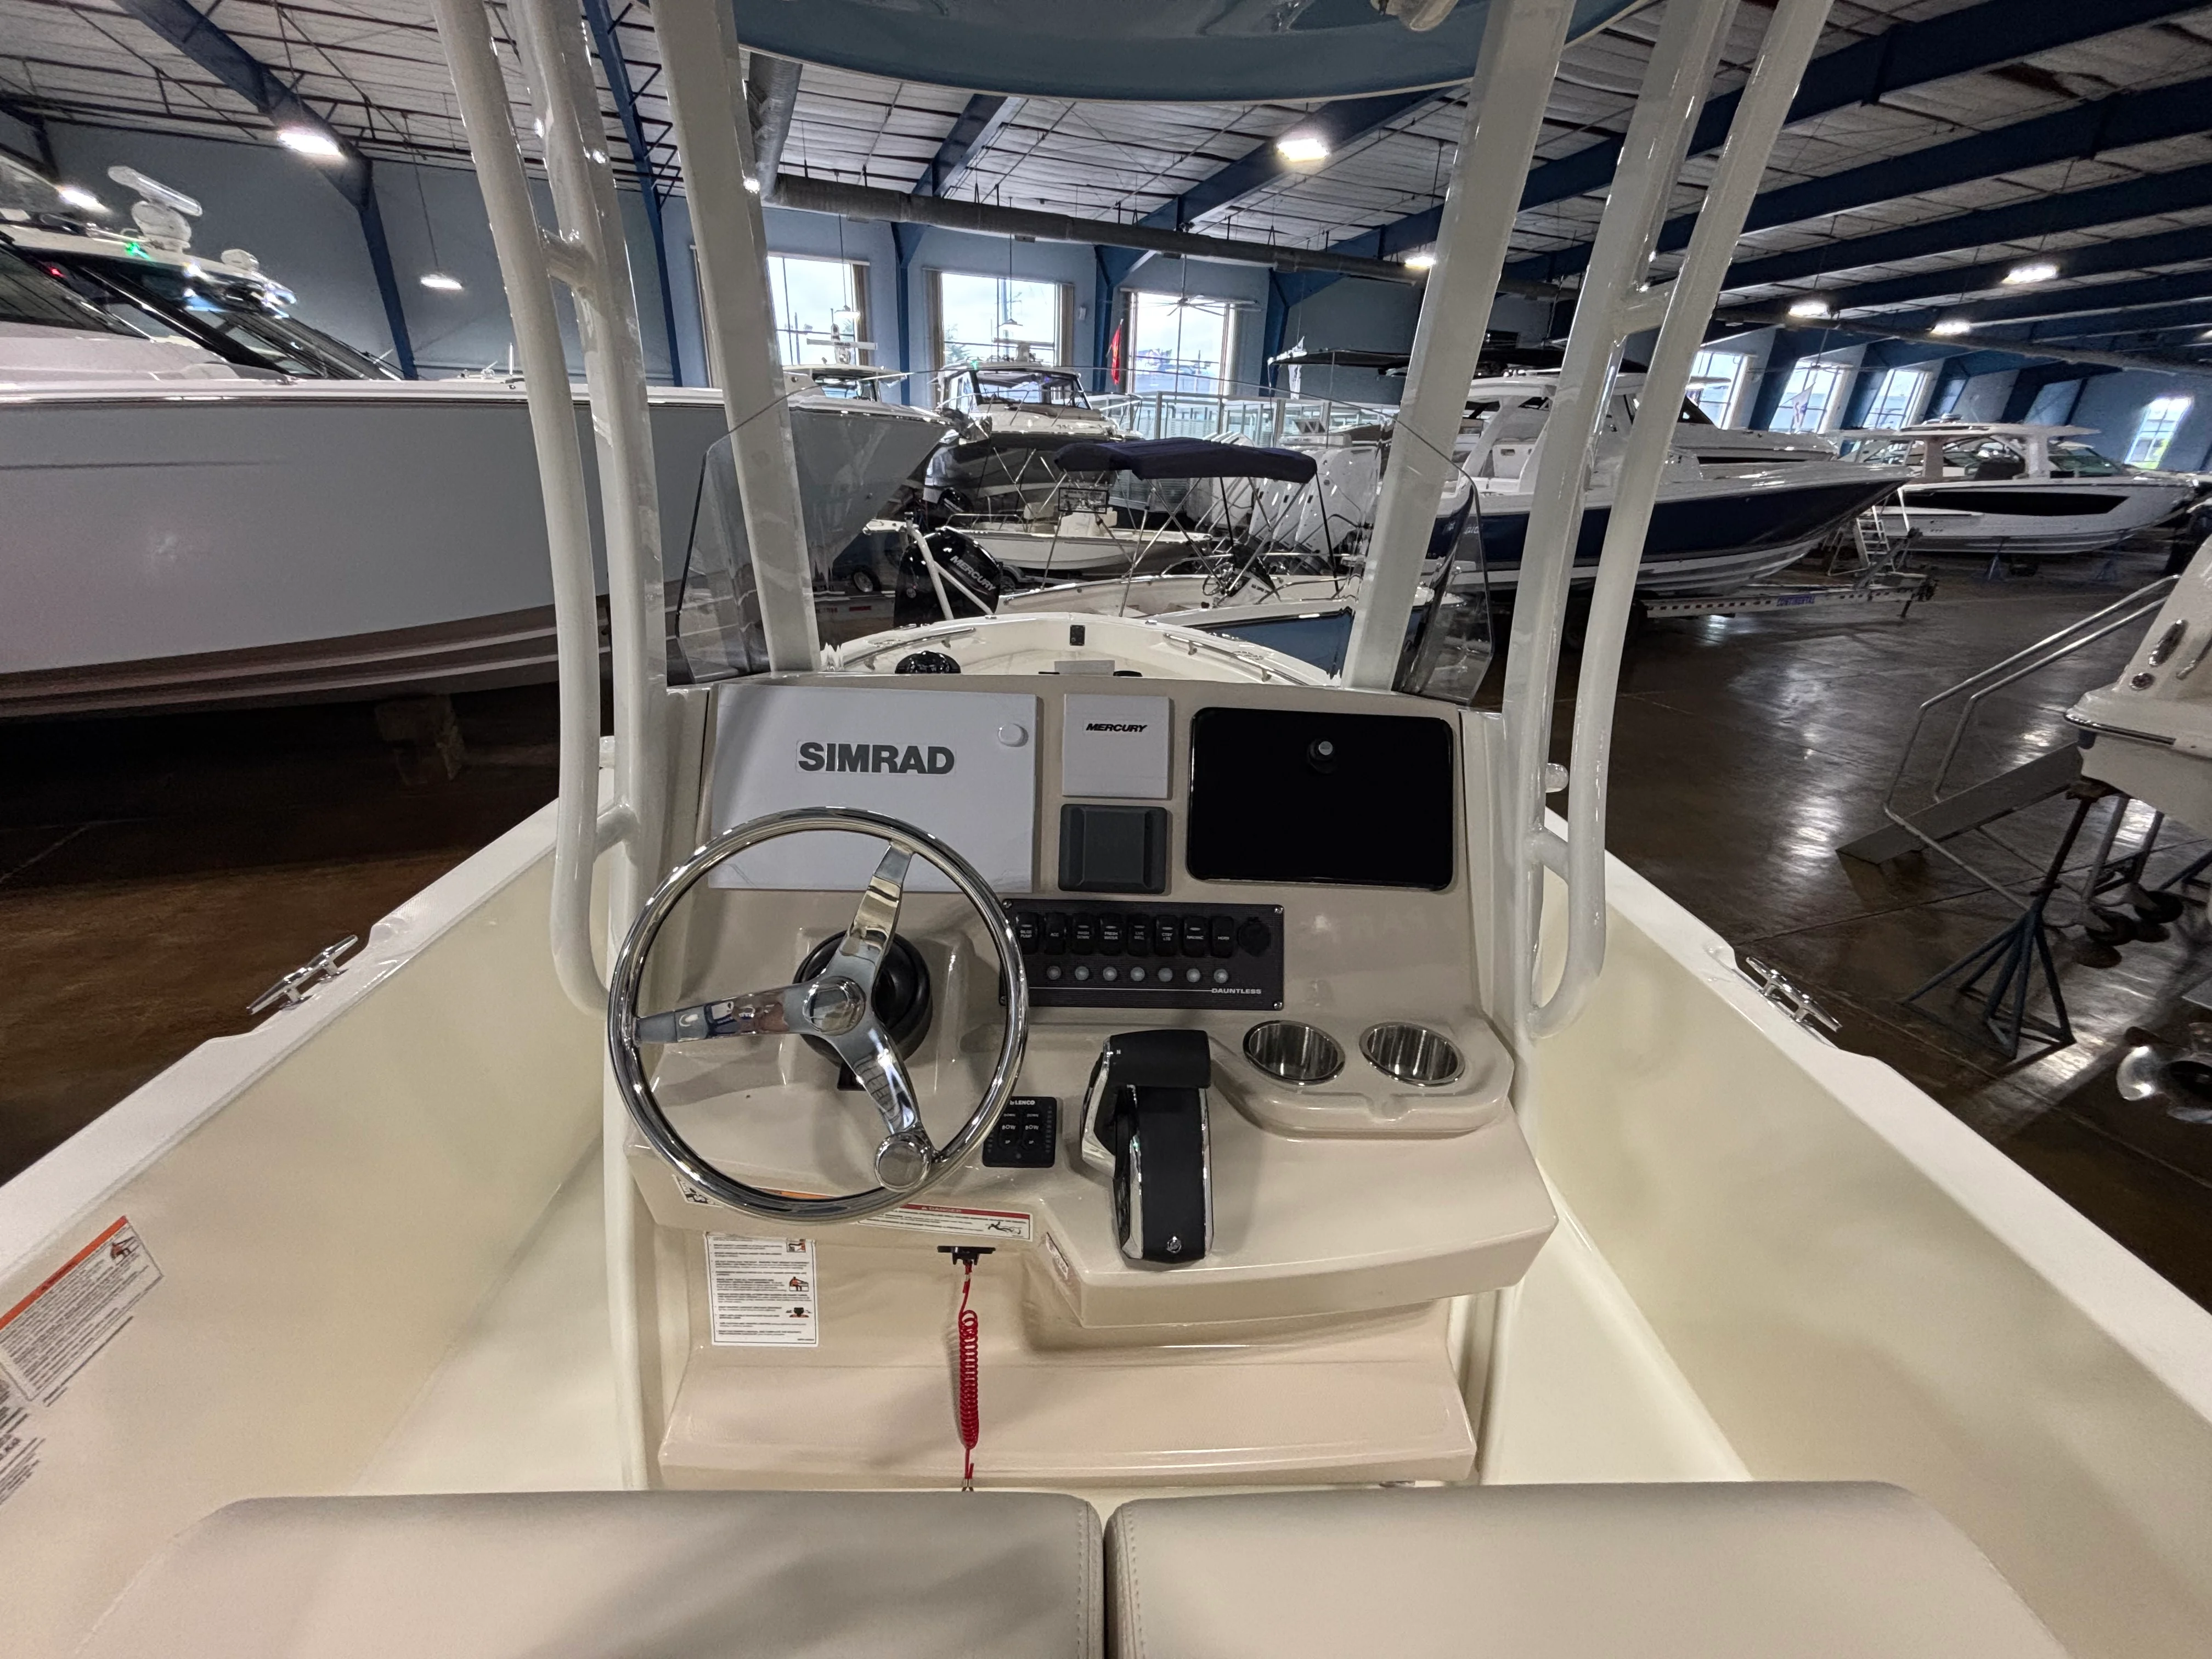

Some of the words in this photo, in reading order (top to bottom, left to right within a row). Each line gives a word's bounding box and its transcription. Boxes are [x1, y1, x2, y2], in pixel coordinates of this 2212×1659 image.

[950, 555, 996, 591] MERCURY
[1086, 723, 1148, 732] MERCURY
[798, 742, 955, 775] SIMRAD
